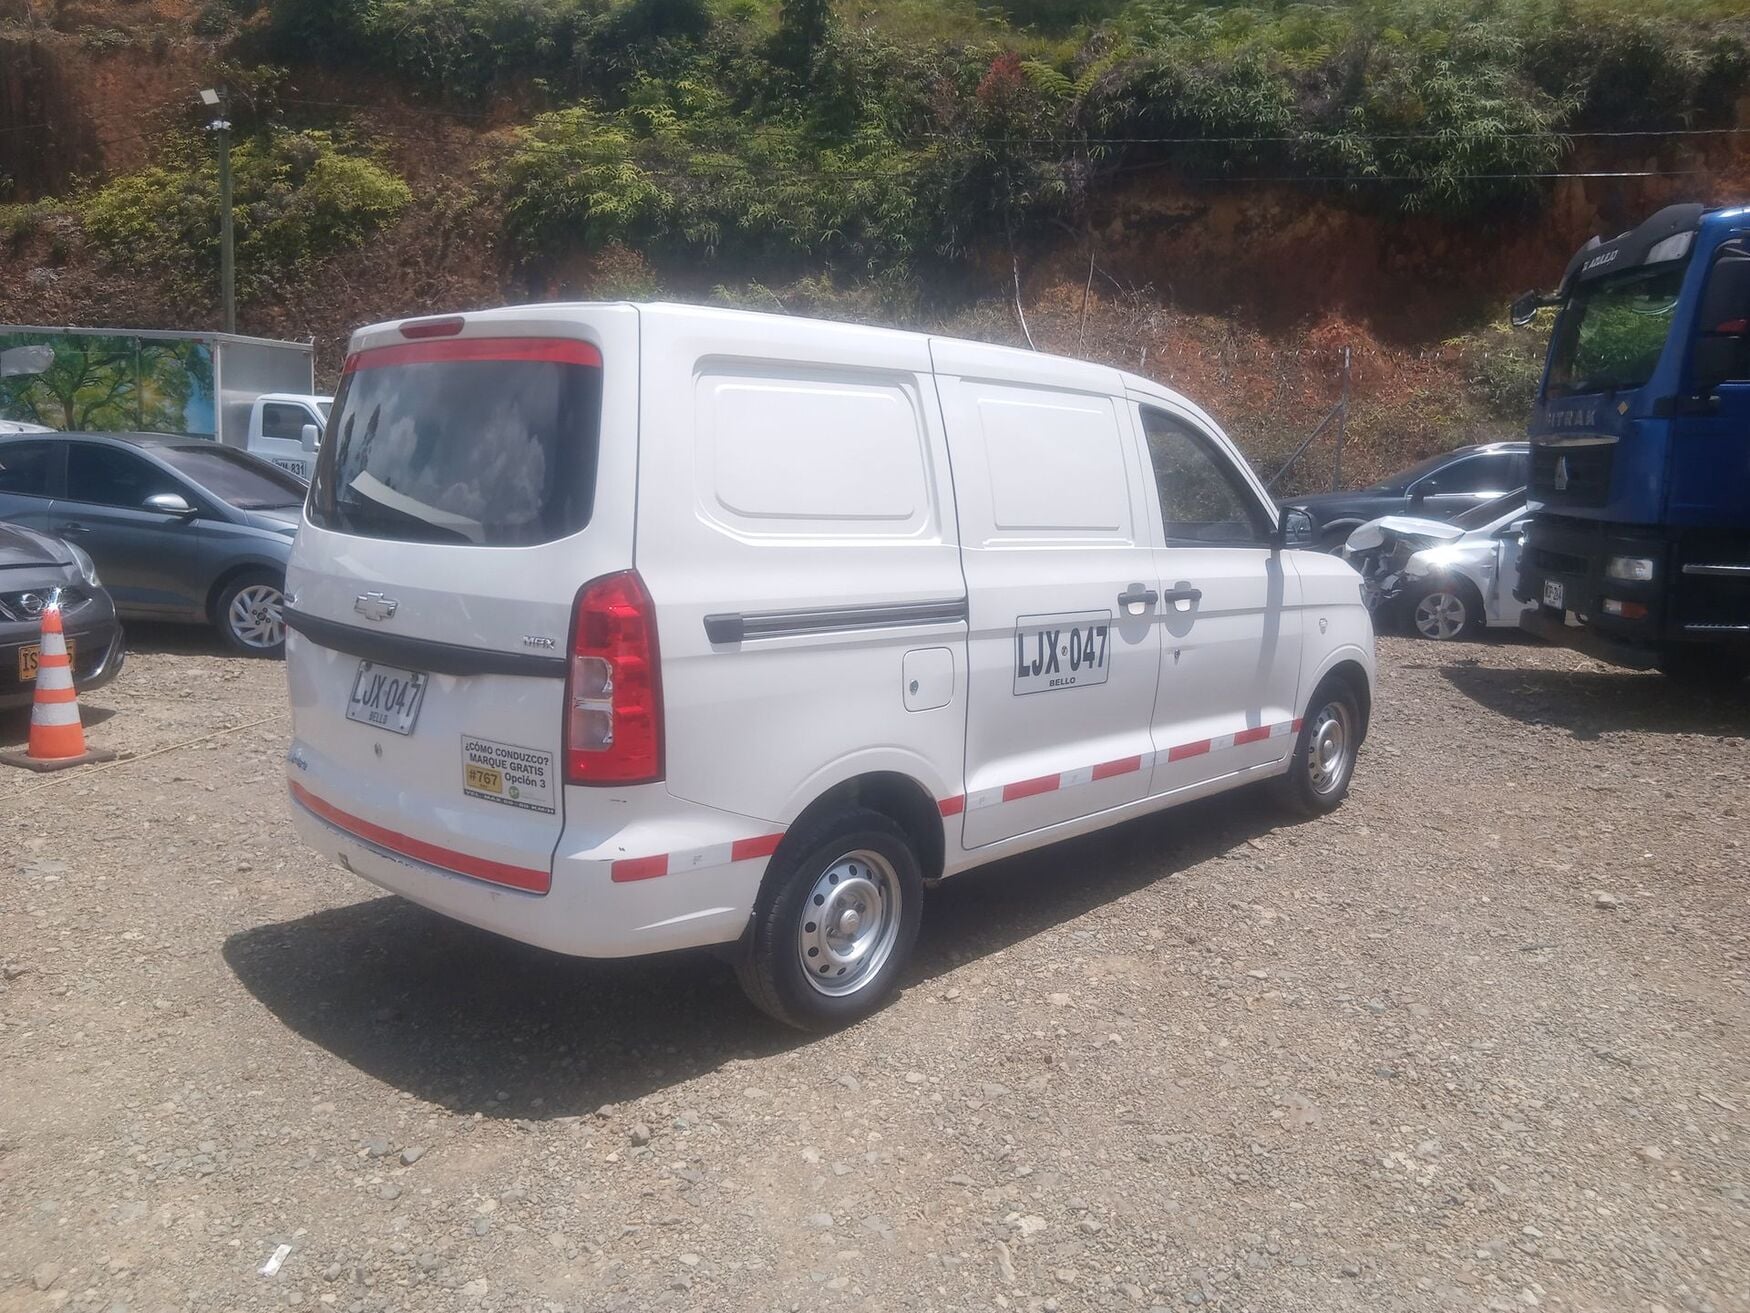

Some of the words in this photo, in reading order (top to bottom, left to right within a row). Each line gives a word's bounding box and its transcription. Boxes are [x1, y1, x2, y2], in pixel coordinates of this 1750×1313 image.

[1049, 677, 1076, 687] BELLO
[465, 741, 493, 755] ¿CÓMO
[495, 748, 549, 766] CONDUZCO?
[469, 752, 508, 769] MARQUE
[509, 761, 544, 776] GRATIS
[469, 769, 498, 786] #767
[504, 772, 537, 788] Opción
[540, 779, 546, 789] 3
